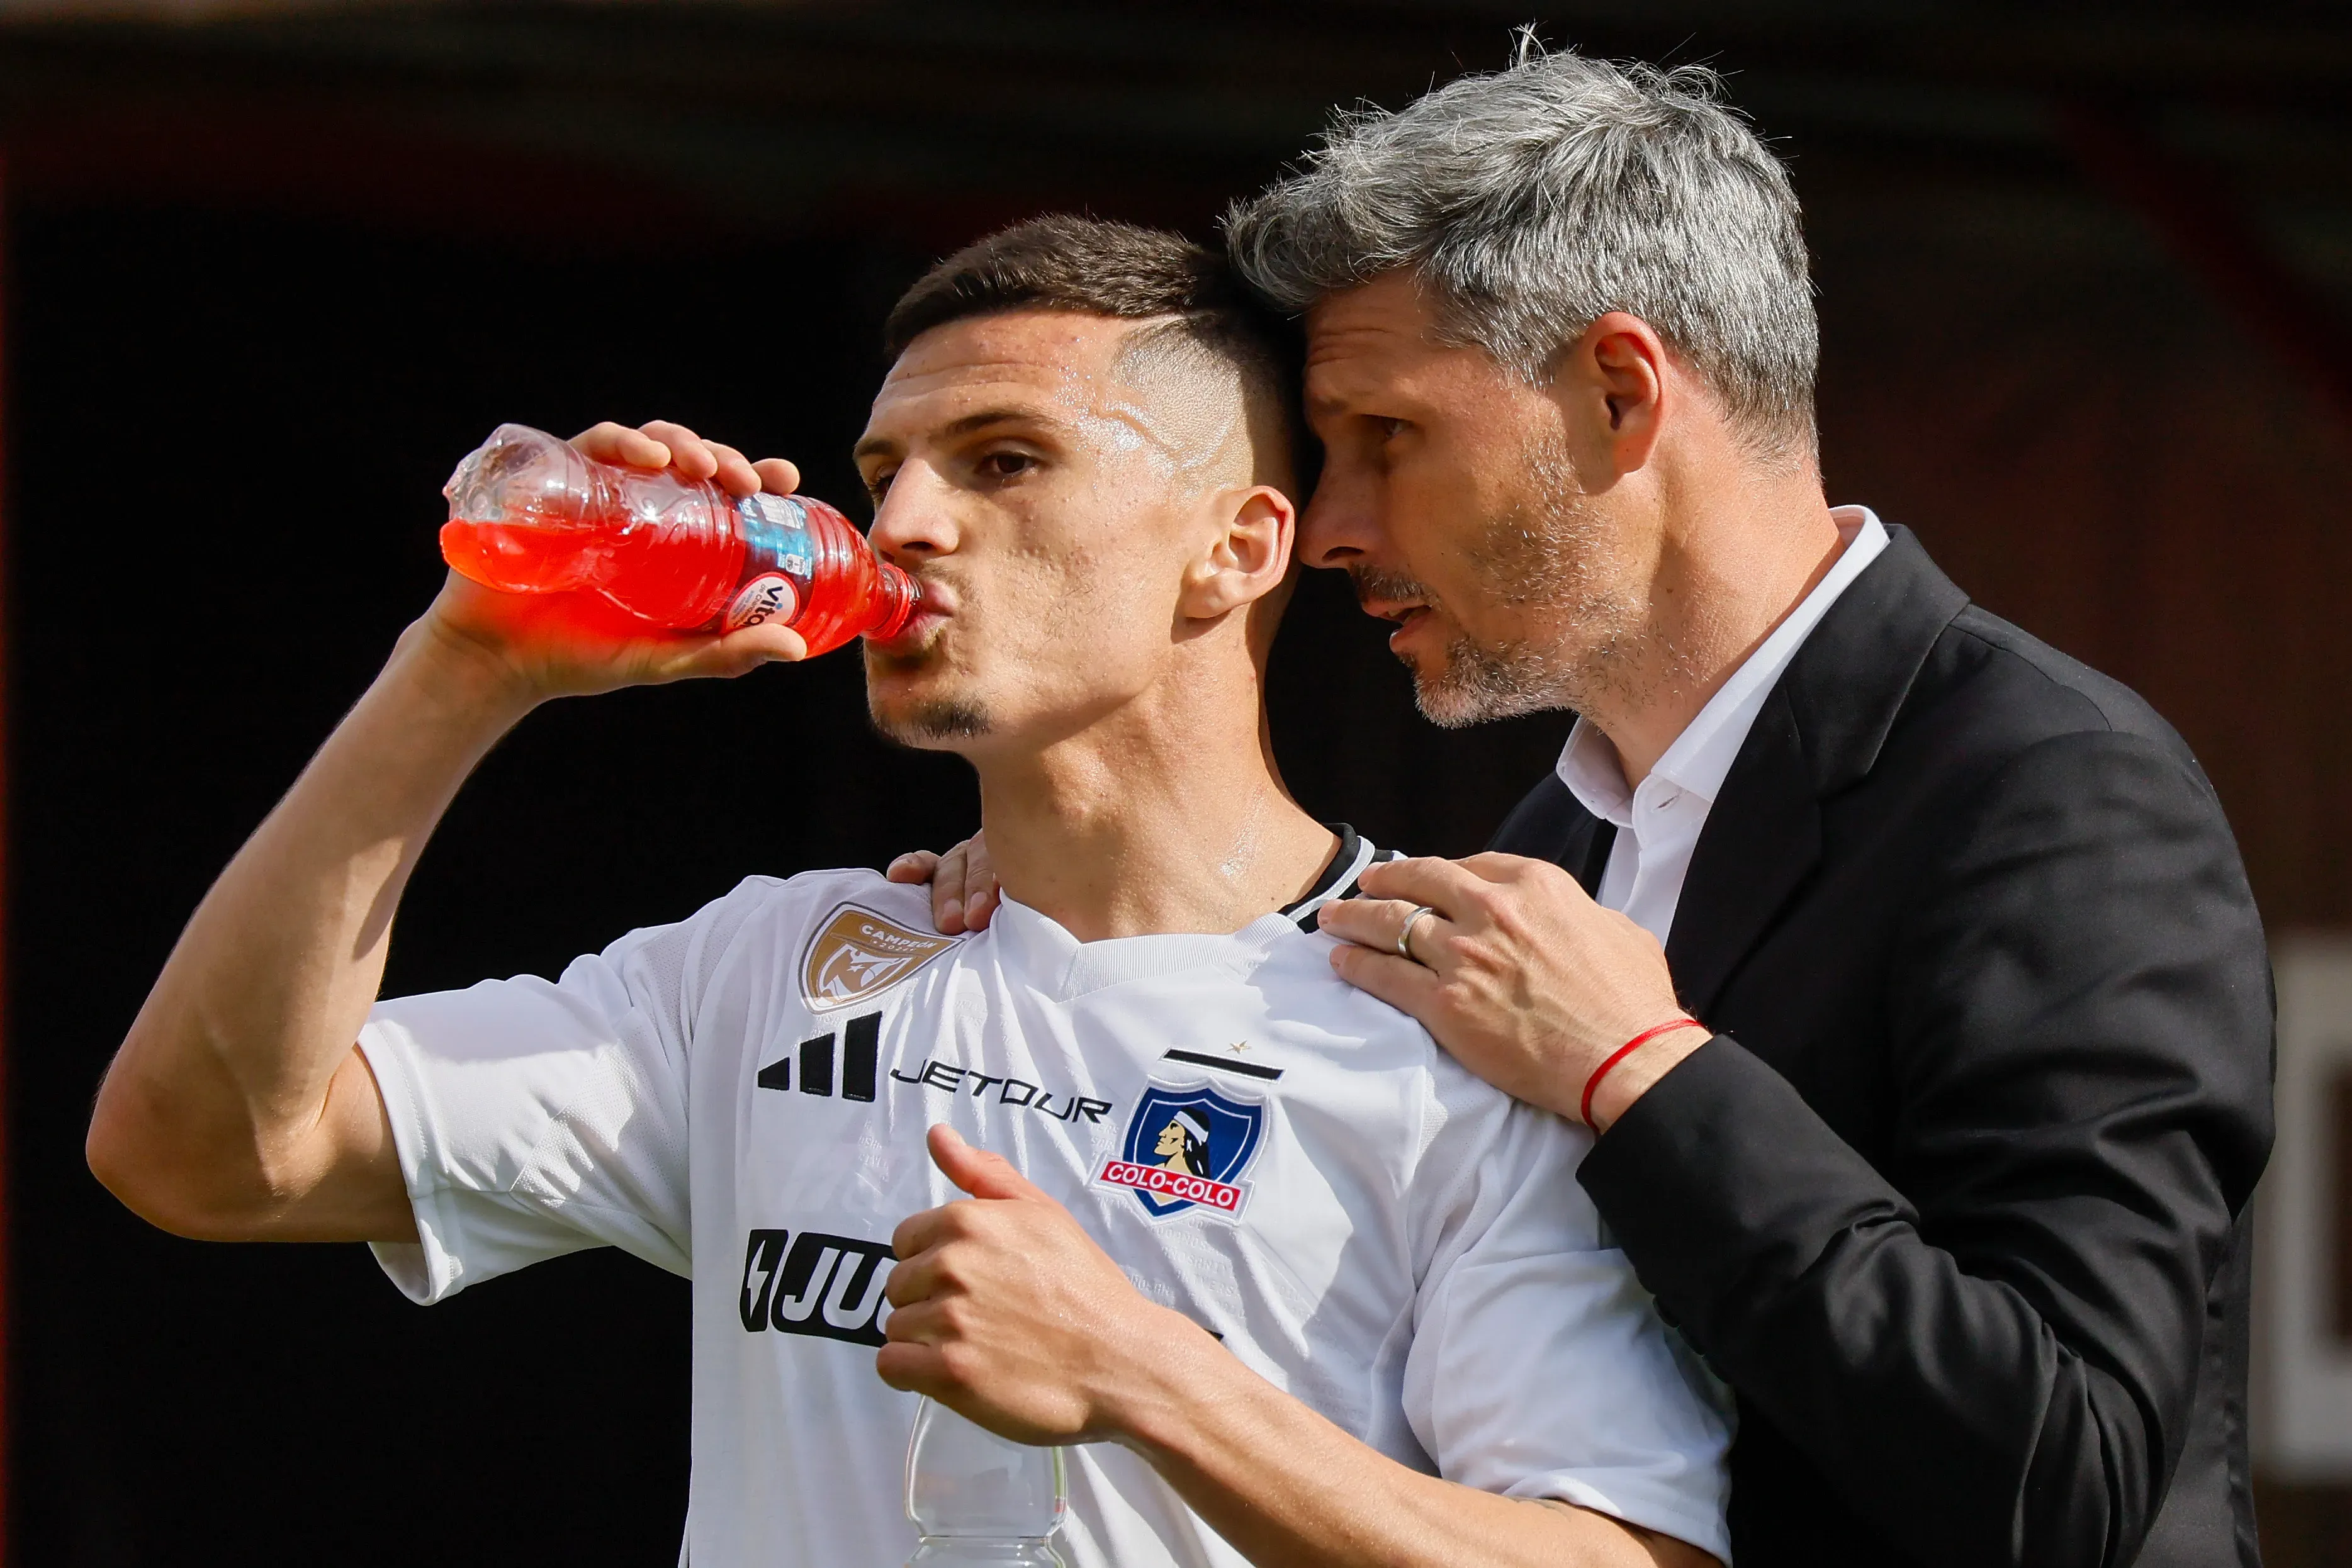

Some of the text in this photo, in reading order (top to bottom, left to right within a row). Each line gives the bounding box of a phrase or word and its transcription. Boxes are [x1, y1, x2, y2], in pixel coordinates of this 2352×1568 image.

[742, 586, 784, 627] vita
[889, 1058, 1113, 1124] JETOUR
[1107, 1164, 1234, 1207] COLO-COLO
[782, 1246, 899, 1335] JU
